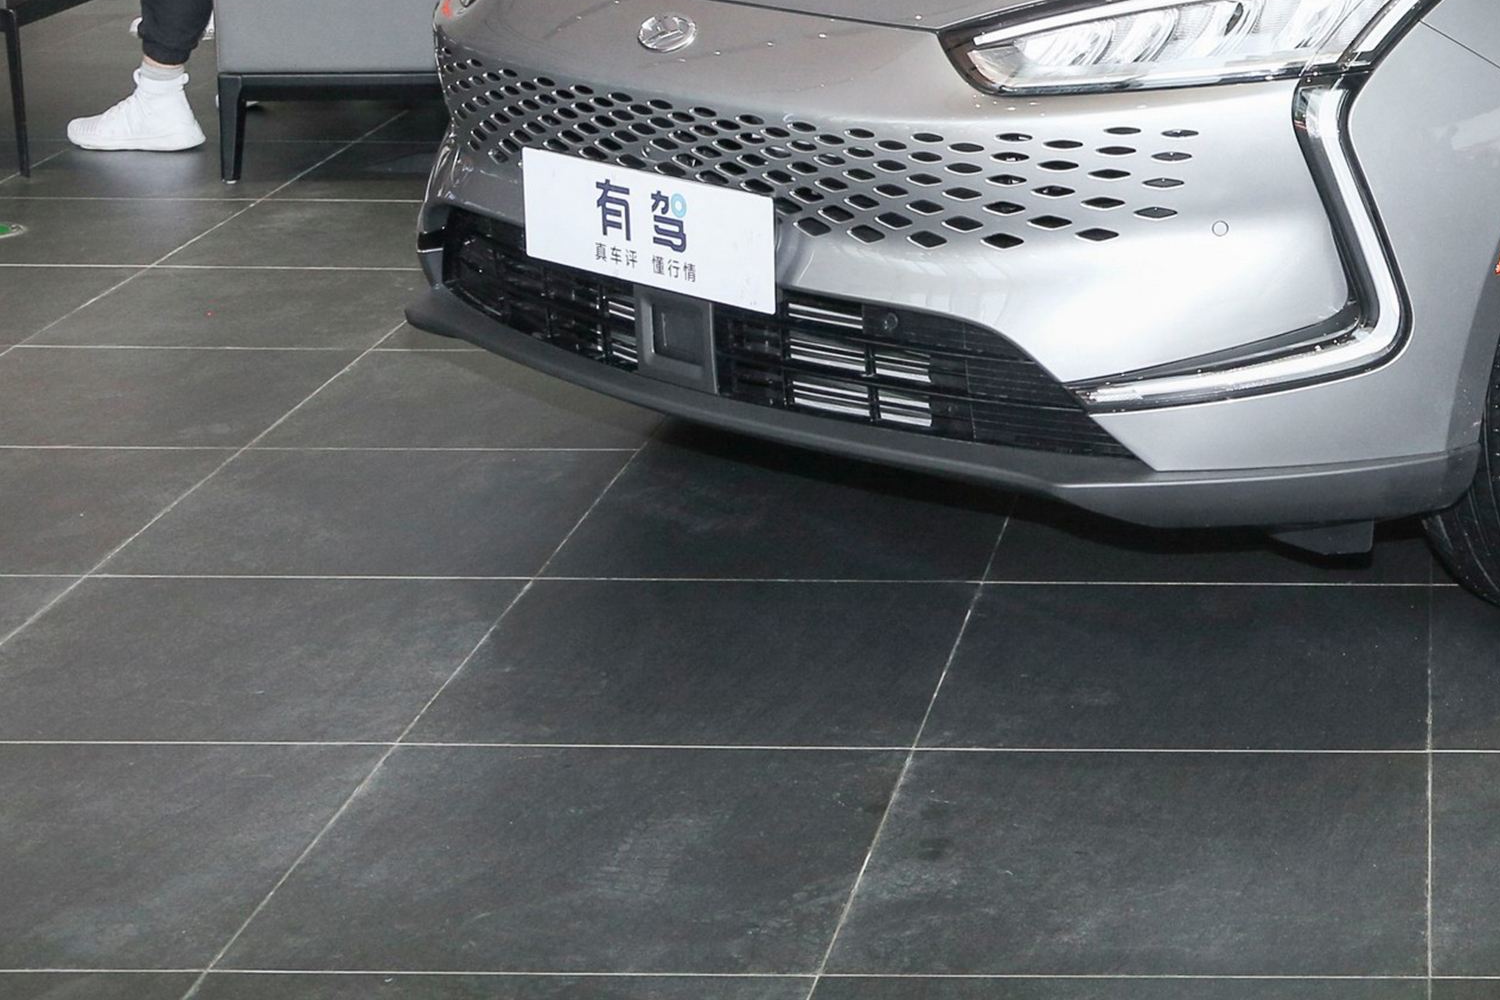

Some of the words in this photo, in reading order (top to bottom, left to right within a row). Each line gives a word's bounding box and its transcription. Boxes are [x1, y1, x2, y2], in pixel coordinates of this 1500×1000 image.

[595, 178, 687, 253] 有驾
[595, 241, 638, 269] 真车评
[651, 255, 697, 283] 懂行情
